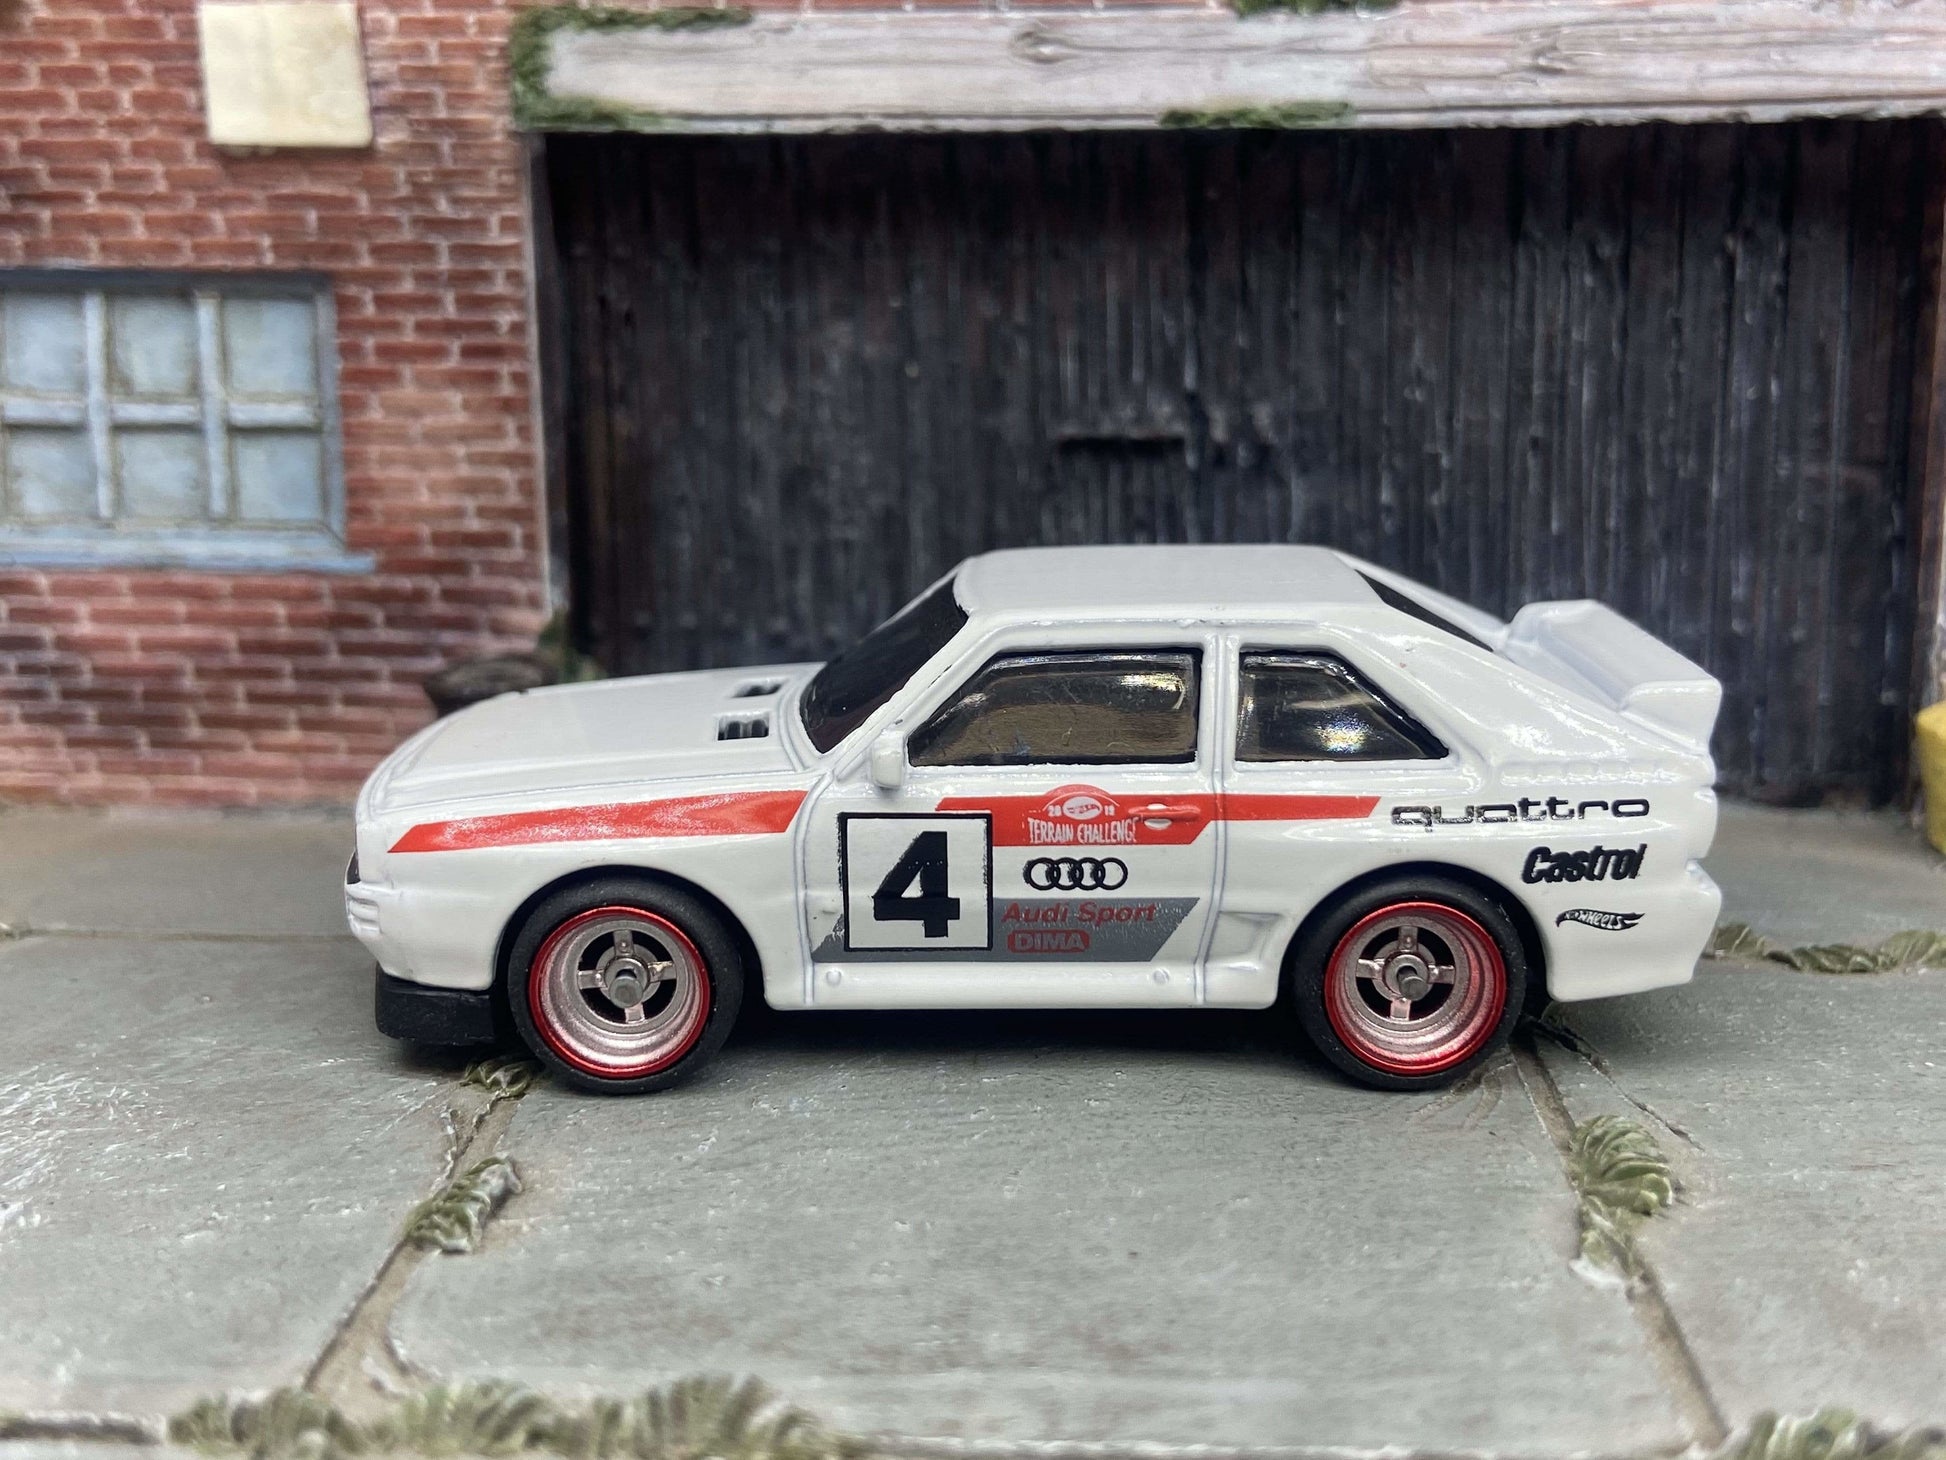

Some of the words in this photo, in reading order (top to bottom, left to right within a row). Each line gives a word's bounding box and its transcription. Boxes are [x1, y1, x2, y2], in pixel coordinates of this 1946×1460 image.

[1391, 797, 1650, 832] quattro
[1027, 817, 1074, 844] TERRAIN
[1521, 843, 1649, 885] Castrol
[872, 831, 960, 938] 4
[1000, 901, 1069, 923] Audi
[1077, 901, 1158, 927] Sport
[1014, 932, 1085, 950] DIMA
